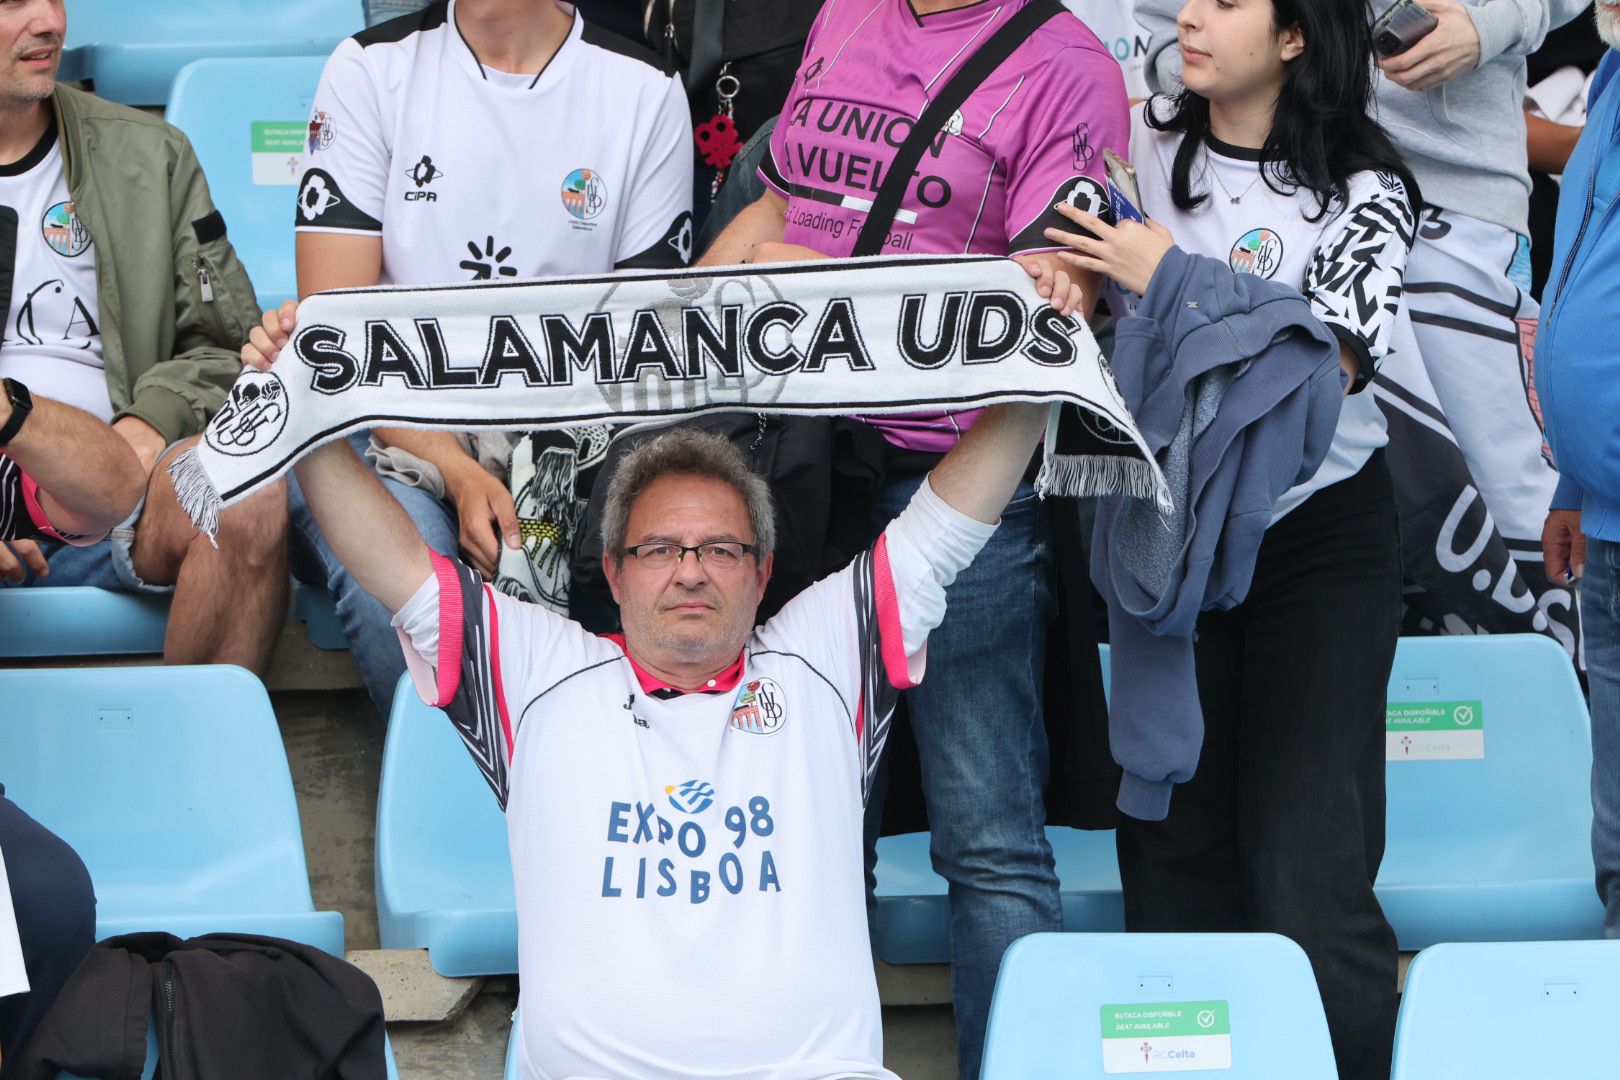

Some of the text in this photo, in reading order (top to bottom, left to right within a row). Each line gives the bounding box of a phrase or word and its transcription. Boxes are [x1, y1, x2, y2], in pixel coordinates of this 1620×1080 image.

[797, 143, 952, 209] VUELO
[792, 205, 845, 239] Loading
[295, 289, 1081, 395] SALAMANCA UDS
[607, 795, 774, 858] EXPO 98
[601, 850, 782, 905] LISBOA
